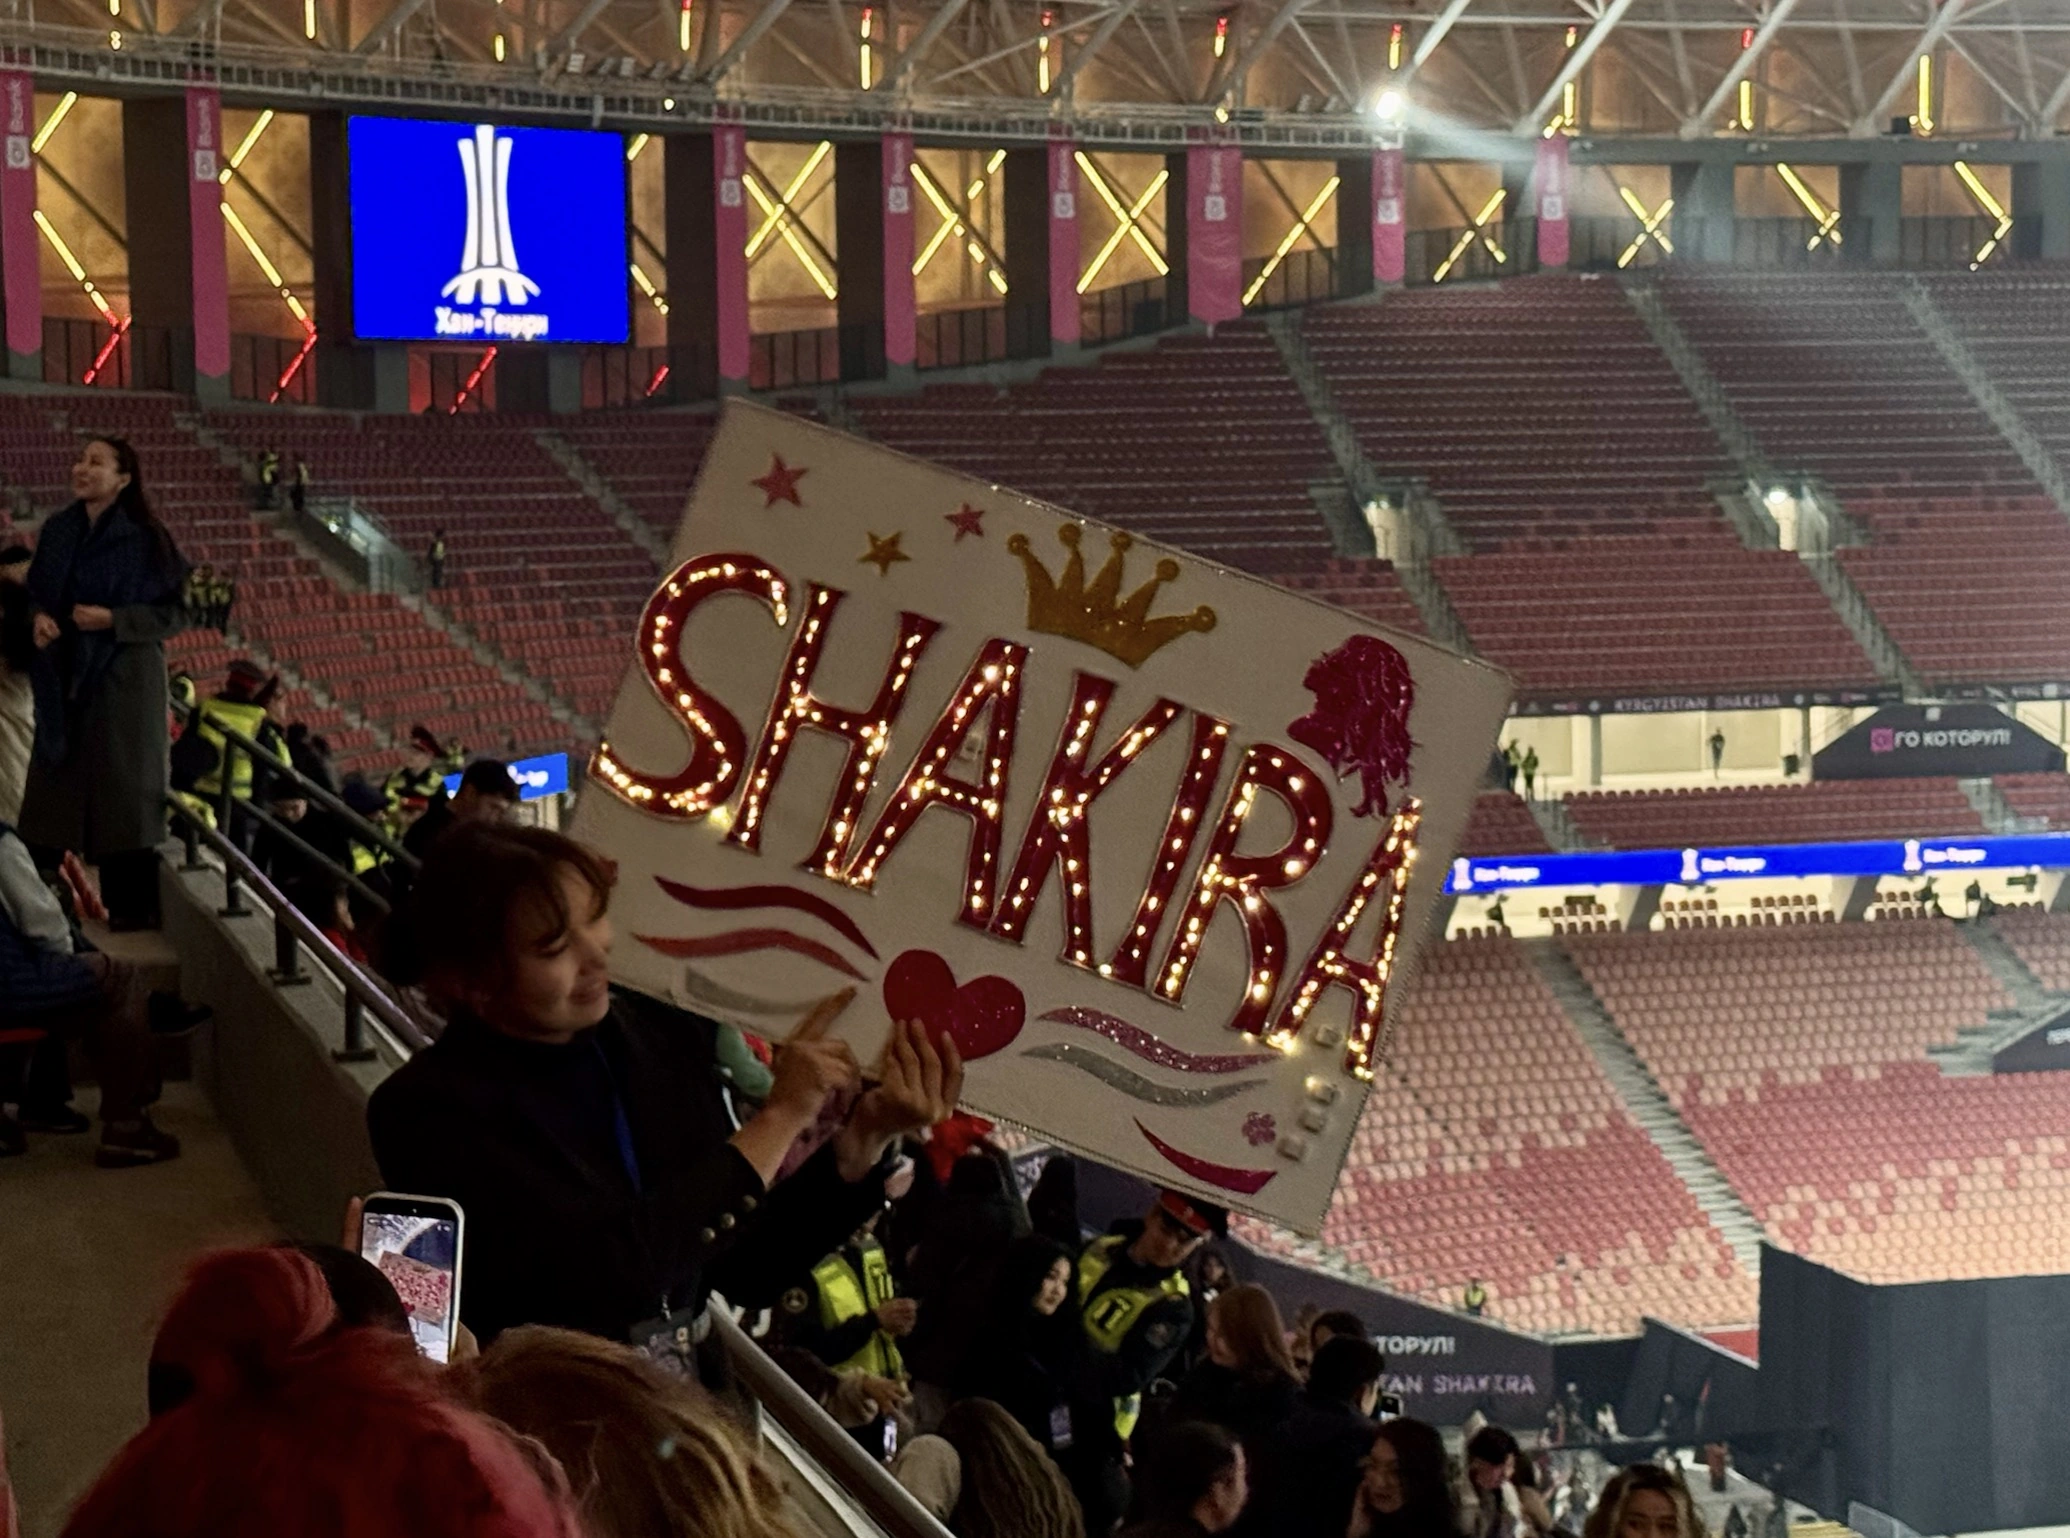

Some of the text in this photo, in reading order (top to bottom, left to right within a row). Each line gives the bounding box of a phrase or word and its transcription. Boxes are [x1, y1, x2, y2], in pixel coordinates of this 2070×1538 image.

[1895, 729, 2012, 748] ГО КОТОРУЛ!
[586, 552, 1424, 1082] SHAKIRA
[1376, 1335, 1455, 1355] ТОРУЛ!
[1433, 1373, 1537, 1394] SHAKIRA
